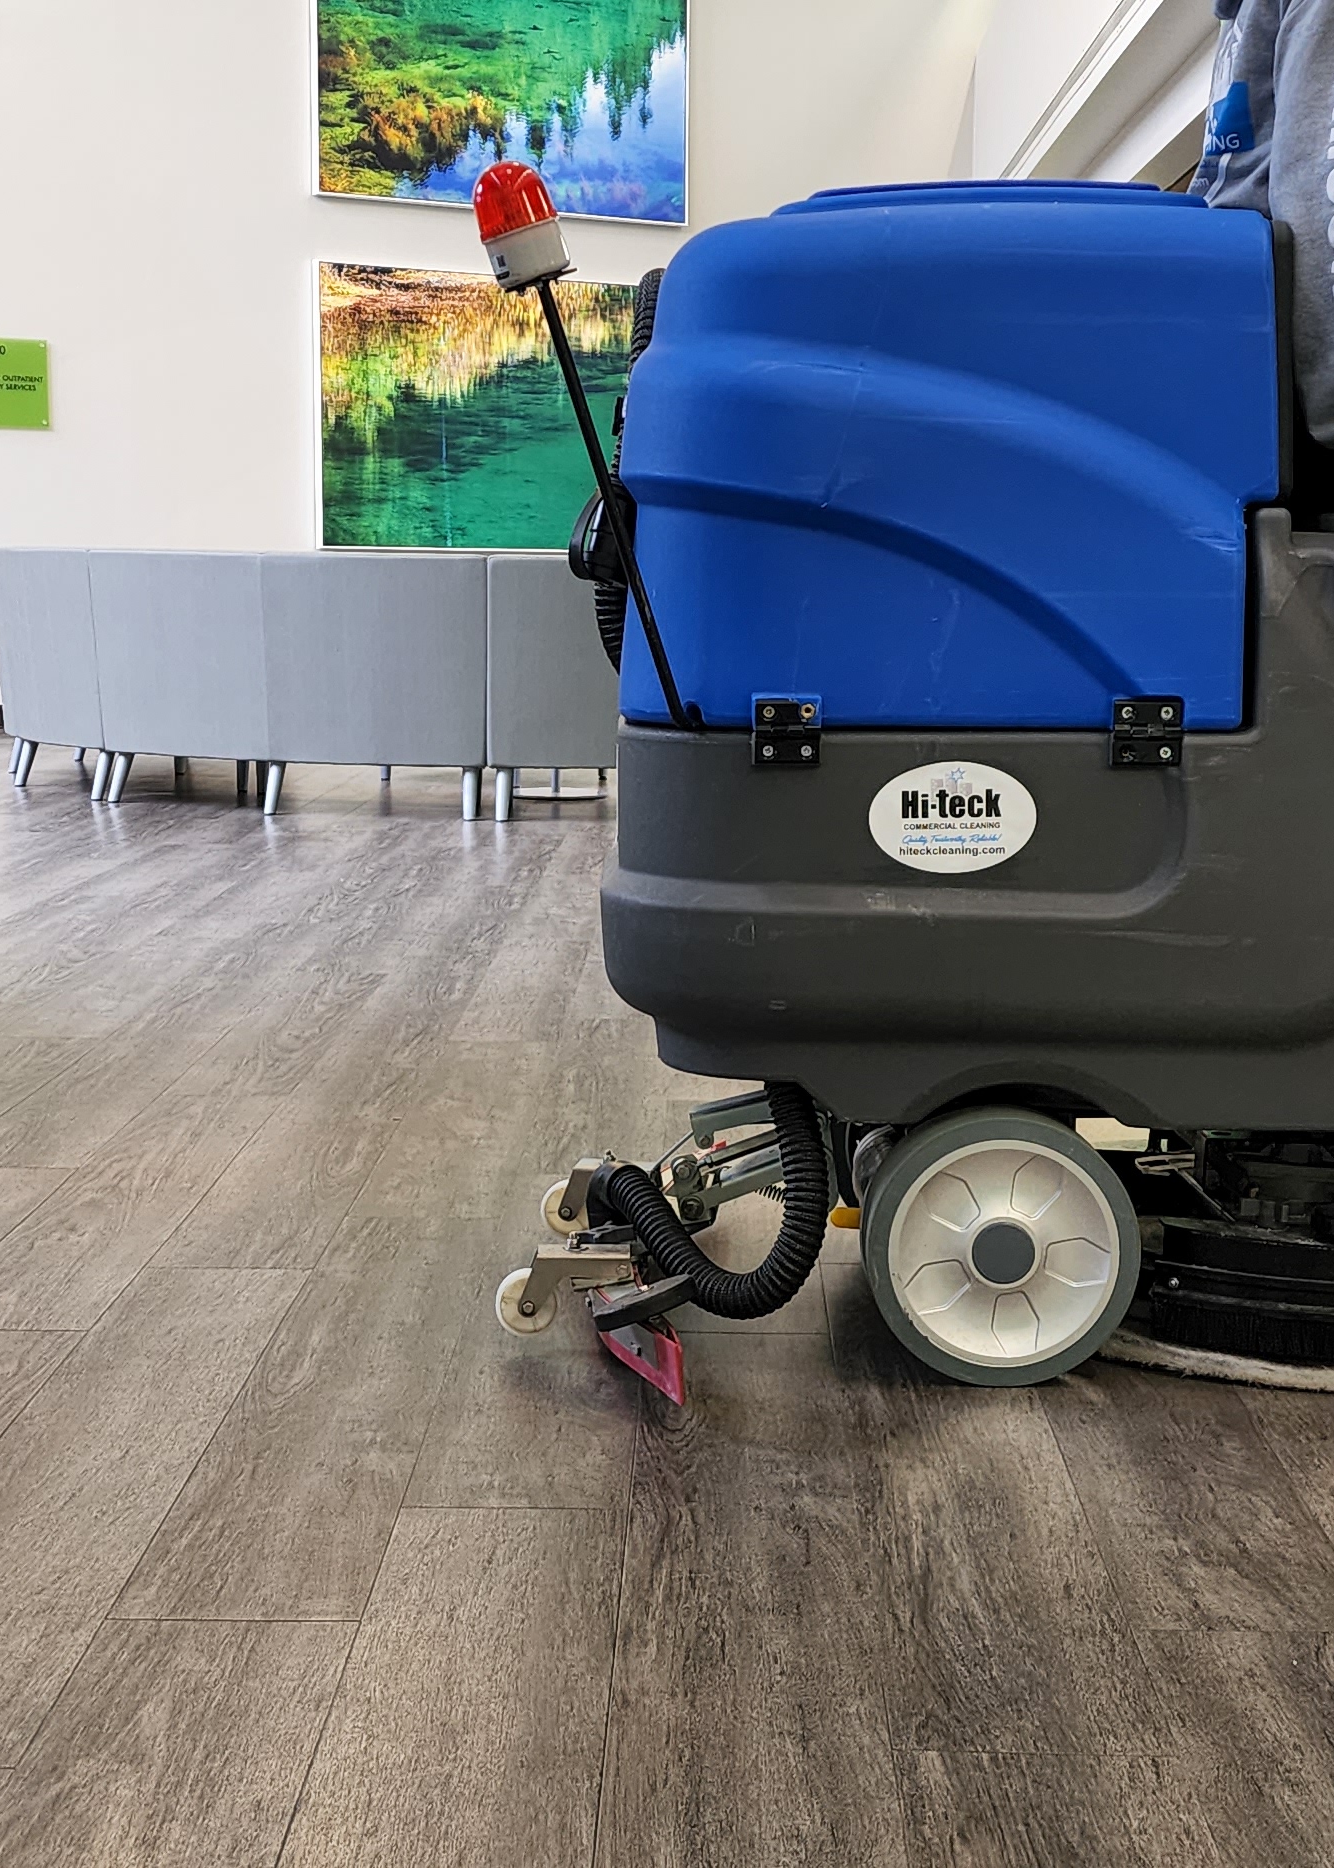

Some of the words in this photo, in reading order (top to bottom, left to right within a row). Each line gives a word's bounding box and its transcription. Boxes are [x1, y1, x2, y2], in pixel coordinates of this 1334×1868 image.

[2, 374, 43, 383] OUTPATIENT
[6, 383, 36, 391] SERVICES
[901, 788, 1002, 819] Hi-teck
[903, 822, 958, 831] COMMERCIAL
[959, 821, 1001, 830] CLEANING
[899, 845, 1006, 857] hiteckcleaning.com
